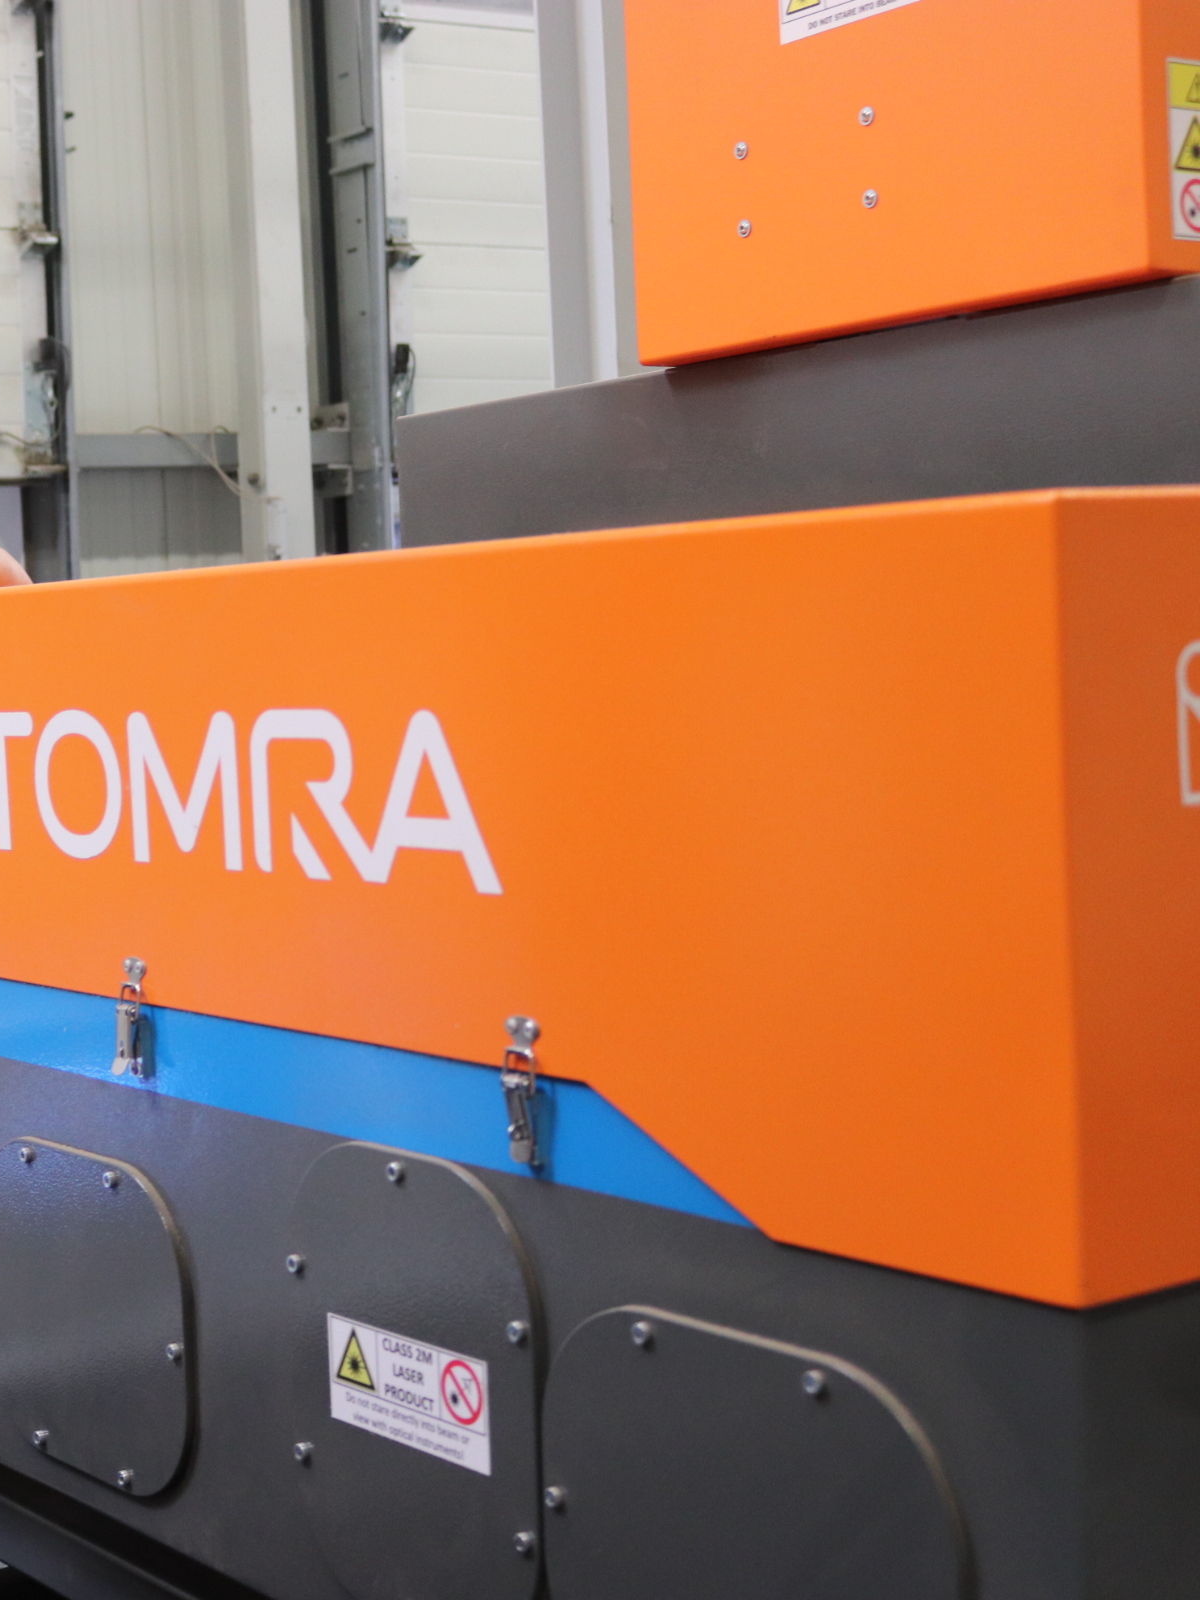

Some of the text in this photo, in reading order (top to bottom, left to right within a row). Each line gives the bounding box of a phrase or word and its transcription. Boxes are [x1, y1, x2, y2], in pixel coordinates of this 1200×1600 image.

[808, 20, 818, 30] DO
[820, 15, 833, 26] NOT
[834, 7, 857, 21] STARE
[858, 2, 875, 14] INTO
[381, 1337, 433, 1365] CLASS 2M
[392, 1363, 424, 1386] LASER
[384, 1383, 434, 1412] PRODUCT
[345, 1391, 469, 1445] Do not stare directly into beam or
[352, 1412, 370, 1425] view
[371, 1418, 388, 1432] with
[389, 1425, 414, 1442] optical
